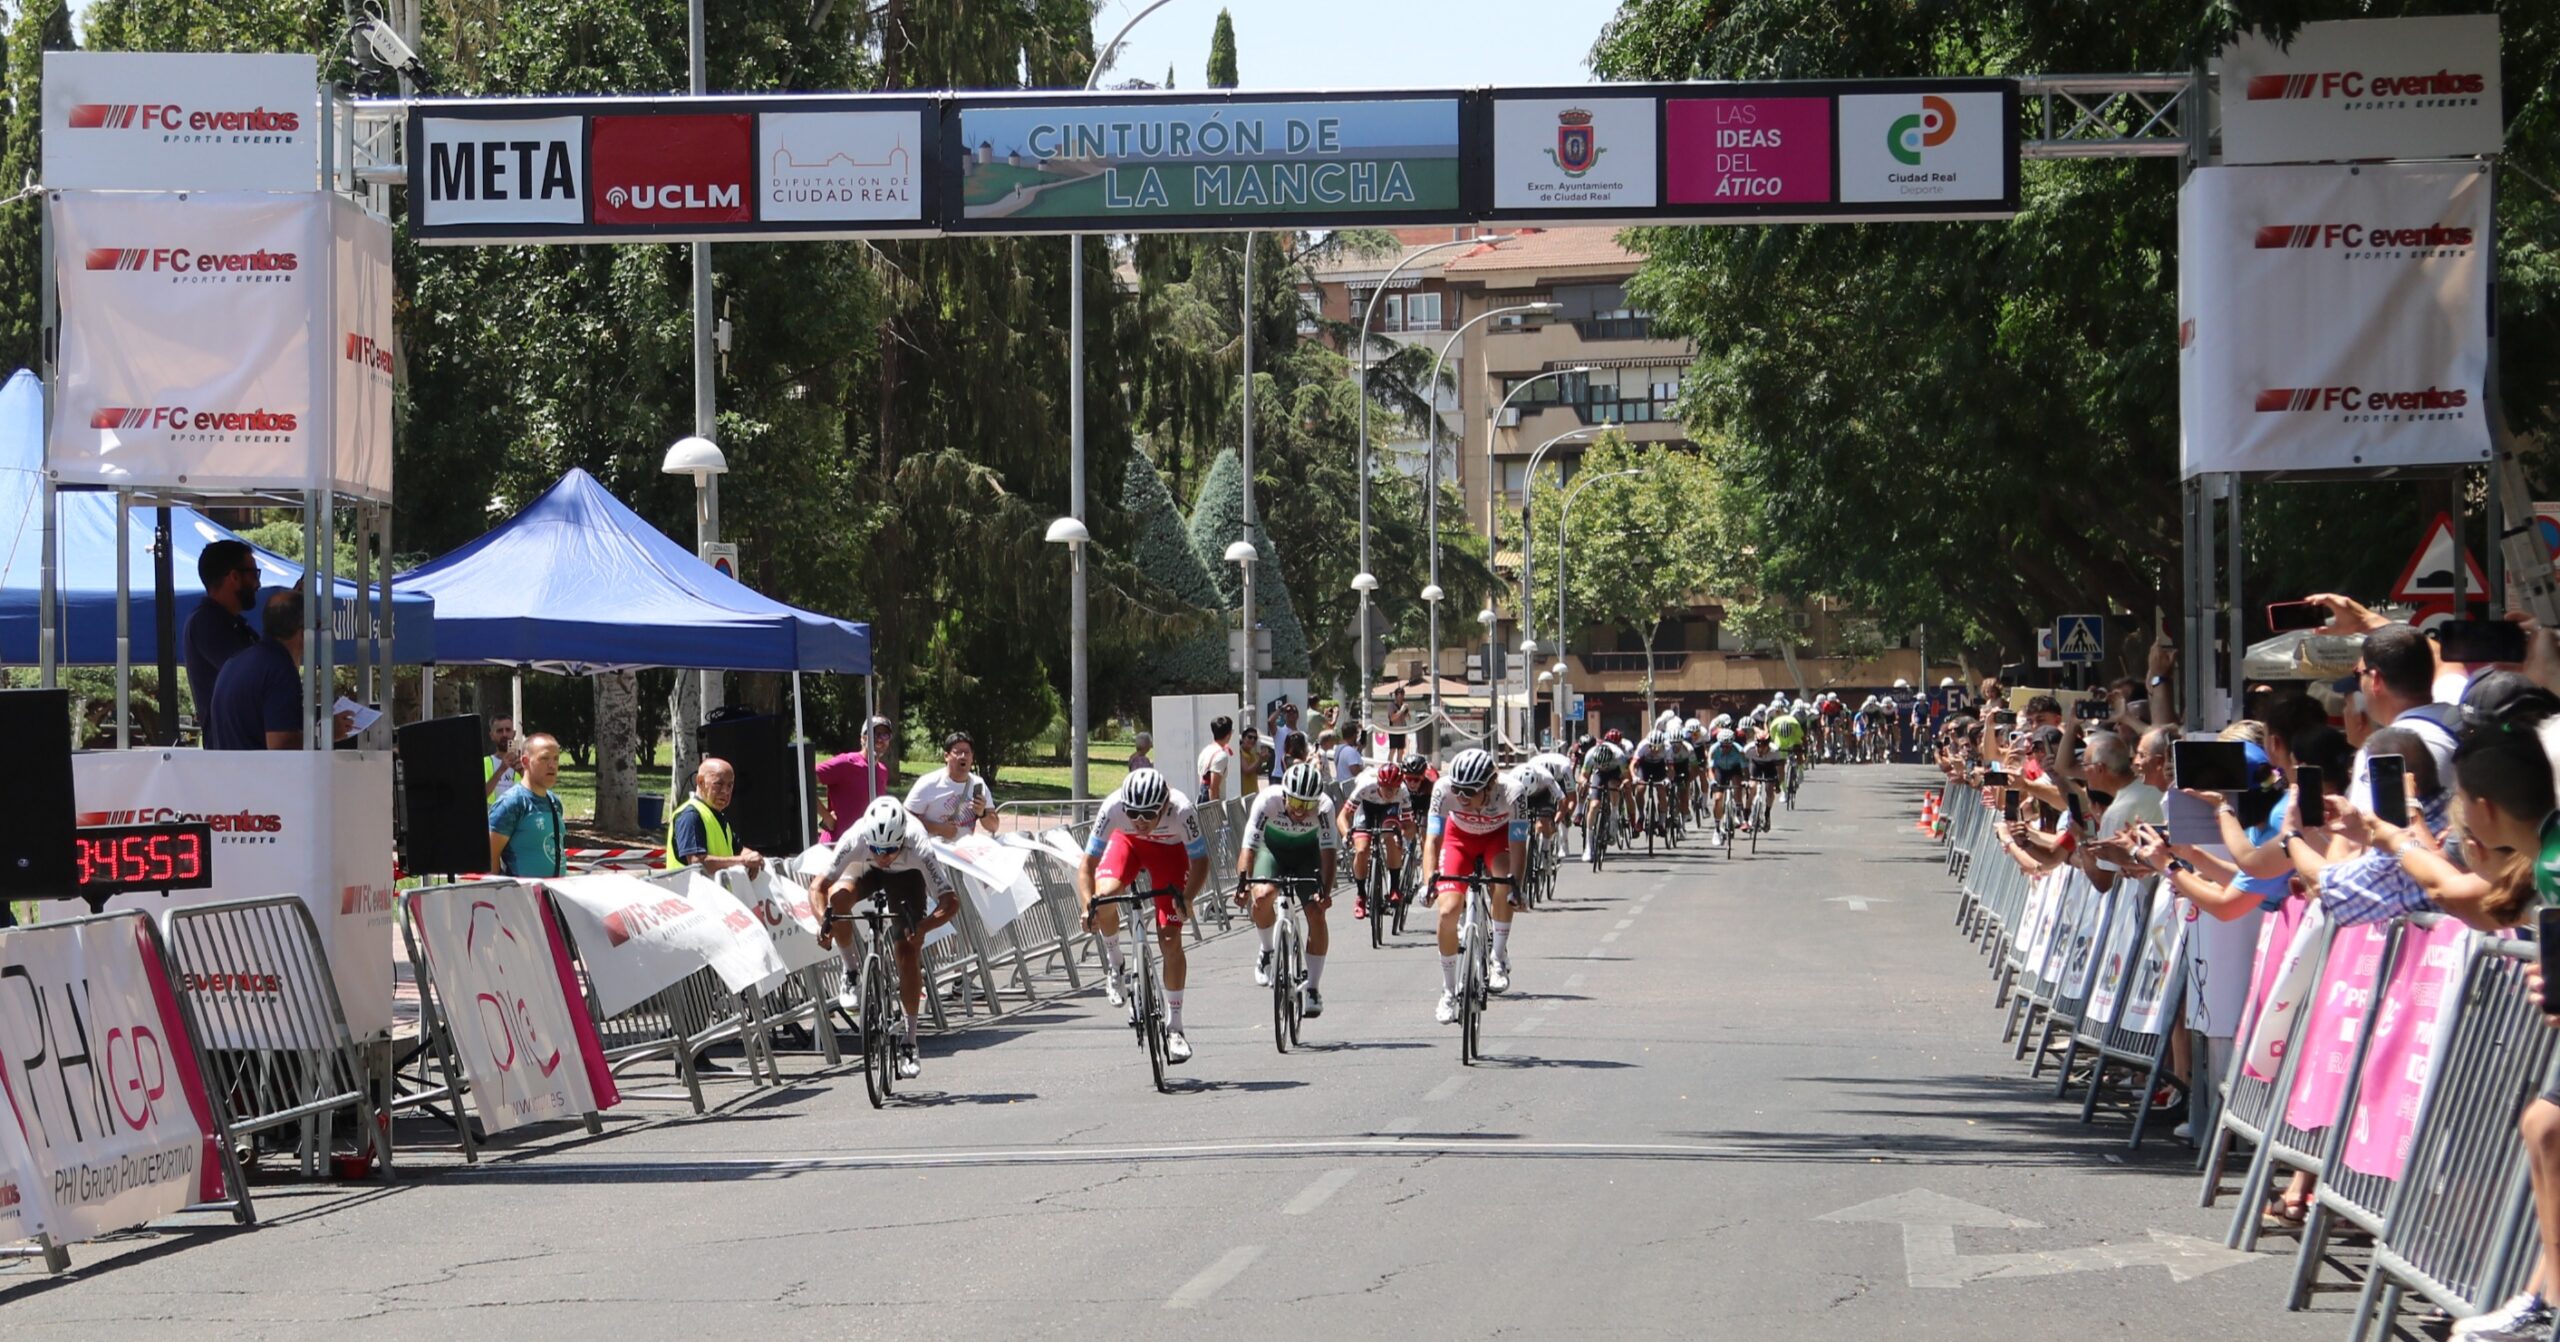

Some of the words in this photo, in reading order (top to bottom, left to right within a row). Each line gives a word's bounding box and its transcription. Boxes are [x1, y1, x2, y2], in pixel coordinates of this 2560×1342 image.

[2321, 71, 2364, 99] FC
[2371, 68, 2484, 97] eventos
[142, 104, 182, 130] FC
[190, 106, 299, 131] eventos
[1716, 105, 1756, 125] LAS
[163, 135, 222, 144] SPORTS
[232, 135, 293, 144] EVENTS
[1027, 110, 1265, 160] CINTURÓN
[1285, 117, 1341, 155] DE
[1716, 129, 1782, 148] IDEAS
[430, 141, 576, 201] META
[1716, 153, 1758, 173] DEL
[772, 175, 883, 188] DIPUTACIÓN
[890, 176, 910, 188] DE
[1105, 166, 1169, 208] LA
[1194, 161, 1416, 207] MANCHA
[1558, 180, 1624, 192] Ayuntamiento
[1715, 176, 1783, 197] ÁTICO
[1887, 172, 1928, 184] Ciudad
[1931, 172, 1957, 183] Real
[631, 183, 741, 210] UCLM
[772, 188, 854, 203] CIUDAD
[861, 187, 909, 202] REAL
[1540, 192, 1551, 202] de
[1553, 191, 1584, 202] Ciudad
[1587, 191, 1611, 202] Real
[1900, 184, 1944, 196] Deporte
[2324, 223, 2363, 249] FC
[2369, 222, 2473, 248] eventos
[152, 248, 191, 272] FC
[197, 248, 298, 272] eventos
[2323, 387, 2361, 411] FC
[2367, 385, 2468, 410] eventos
[152, 406, 189, 430] FC
[194, 407, 298, 432] eventos
[55, 1168, 77, 1207] PHI
